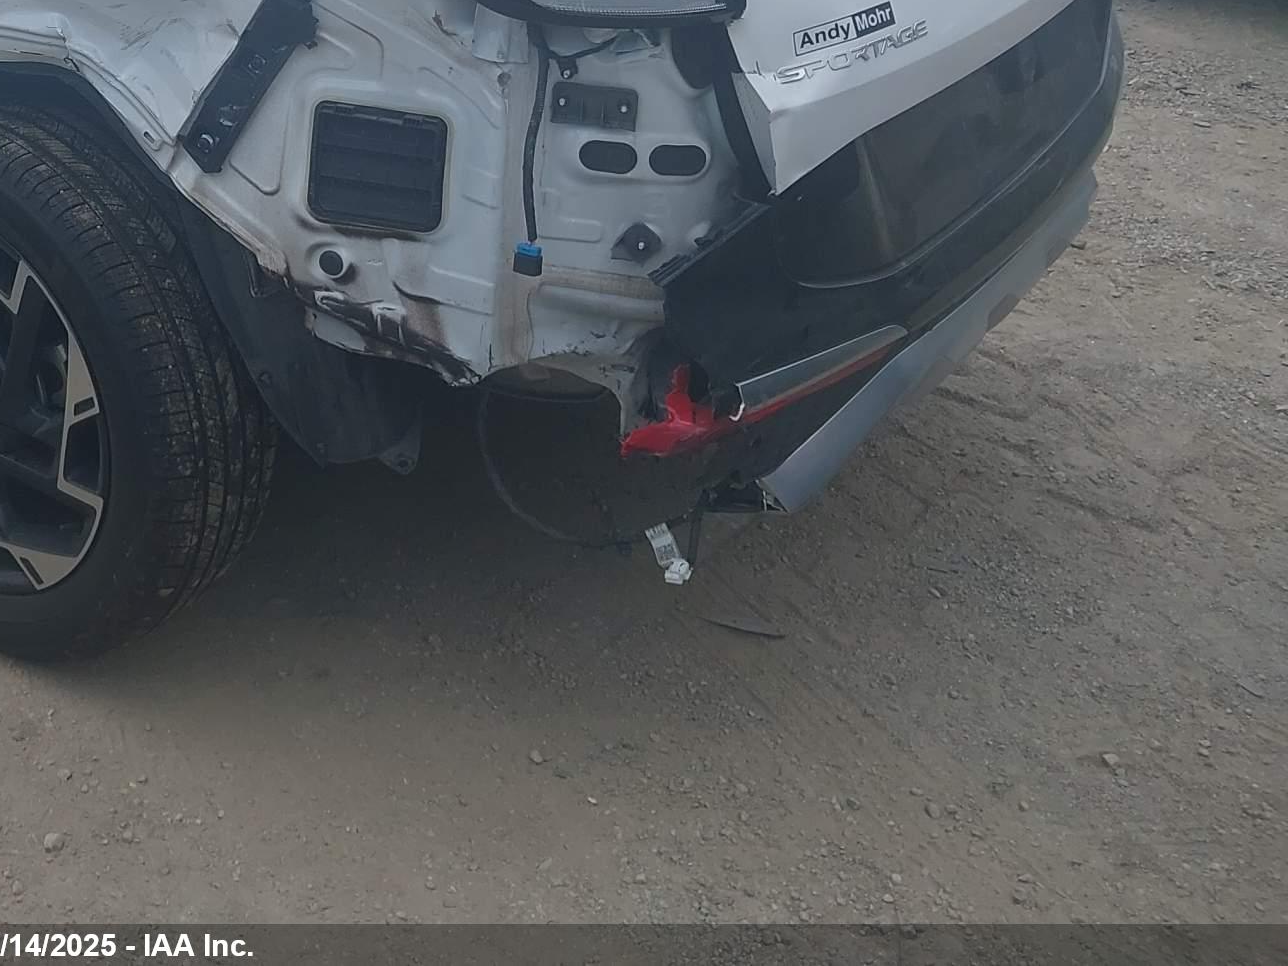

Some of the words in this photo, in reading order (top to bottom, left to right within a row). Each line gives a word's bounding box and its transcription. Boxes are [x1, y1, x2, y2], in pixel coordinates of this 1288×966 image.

[774, 19, 929, 84] SPORTAGE
[799, 22, 852, 49] Andy
[854, 7, 892, 32] Mohr
